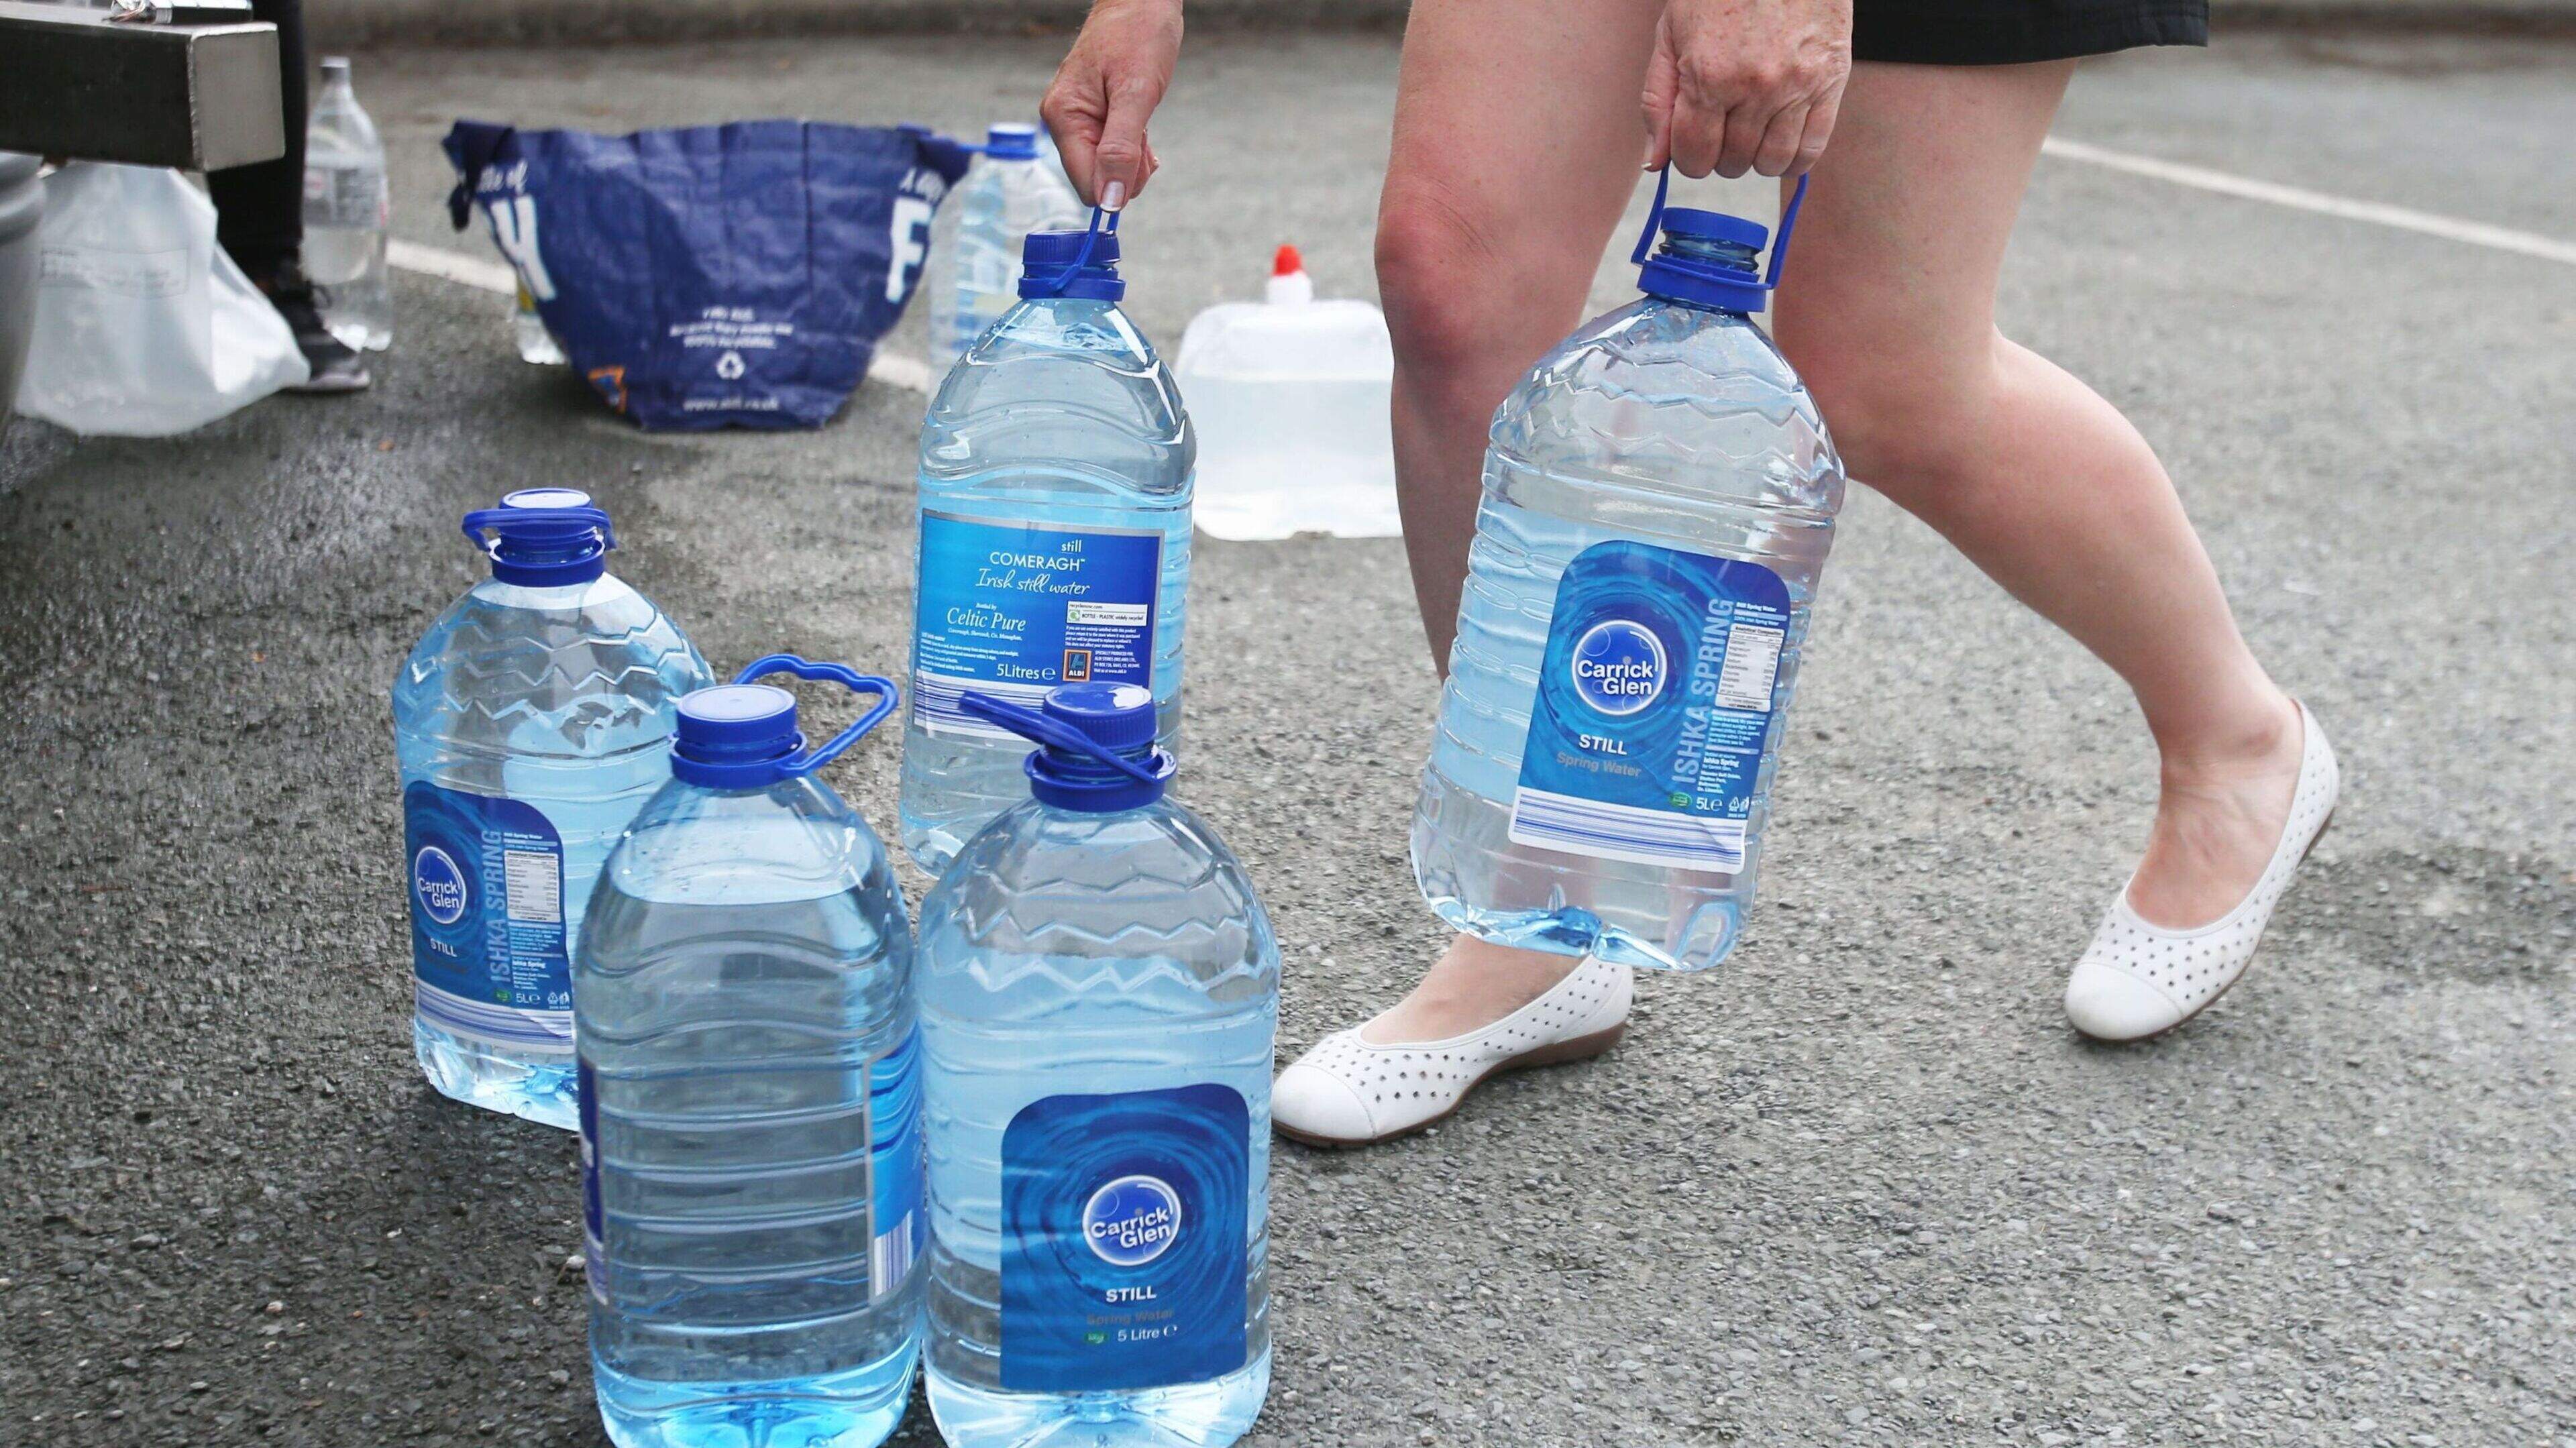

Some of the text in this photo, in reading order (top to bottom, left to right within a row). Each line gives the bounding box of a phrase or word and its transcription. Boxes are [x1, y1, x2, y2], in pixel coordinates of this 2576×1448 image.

[1061, 539, 1082, 553] still
[975, 568, 1090, 595] Irish still water
[947, 607, 1026, 631] Celtic Pure
[1690, 598, 1733, 698] SPRING
[1578, 658, 1654, 678] Carrick
[1603, 677, 1652, 695] Glen
[1578, 734, 1627, 755] STILL
[1671, 705, 1711, 783] ISHKA
[1556, 750, 1642, 777] Spring Water
[418, 877, 458, 894] Carrick
[432, 893, 460, 908] Glen
[482, 830, 511, 982] ISHKA SPRING
[430, 938, 458, 957] STILL
[1091, 1207, 1169, 1238] Carrick
[1120, 1224, 1171, 1248] Glen
[1106, 1286, 1158, 1303] STILL
[1087, 1308, 1174, 1326] Spring Water
[1118, 1329, 1128, 1342] 5
[1131, 1327, 1160, 1341] Litre
